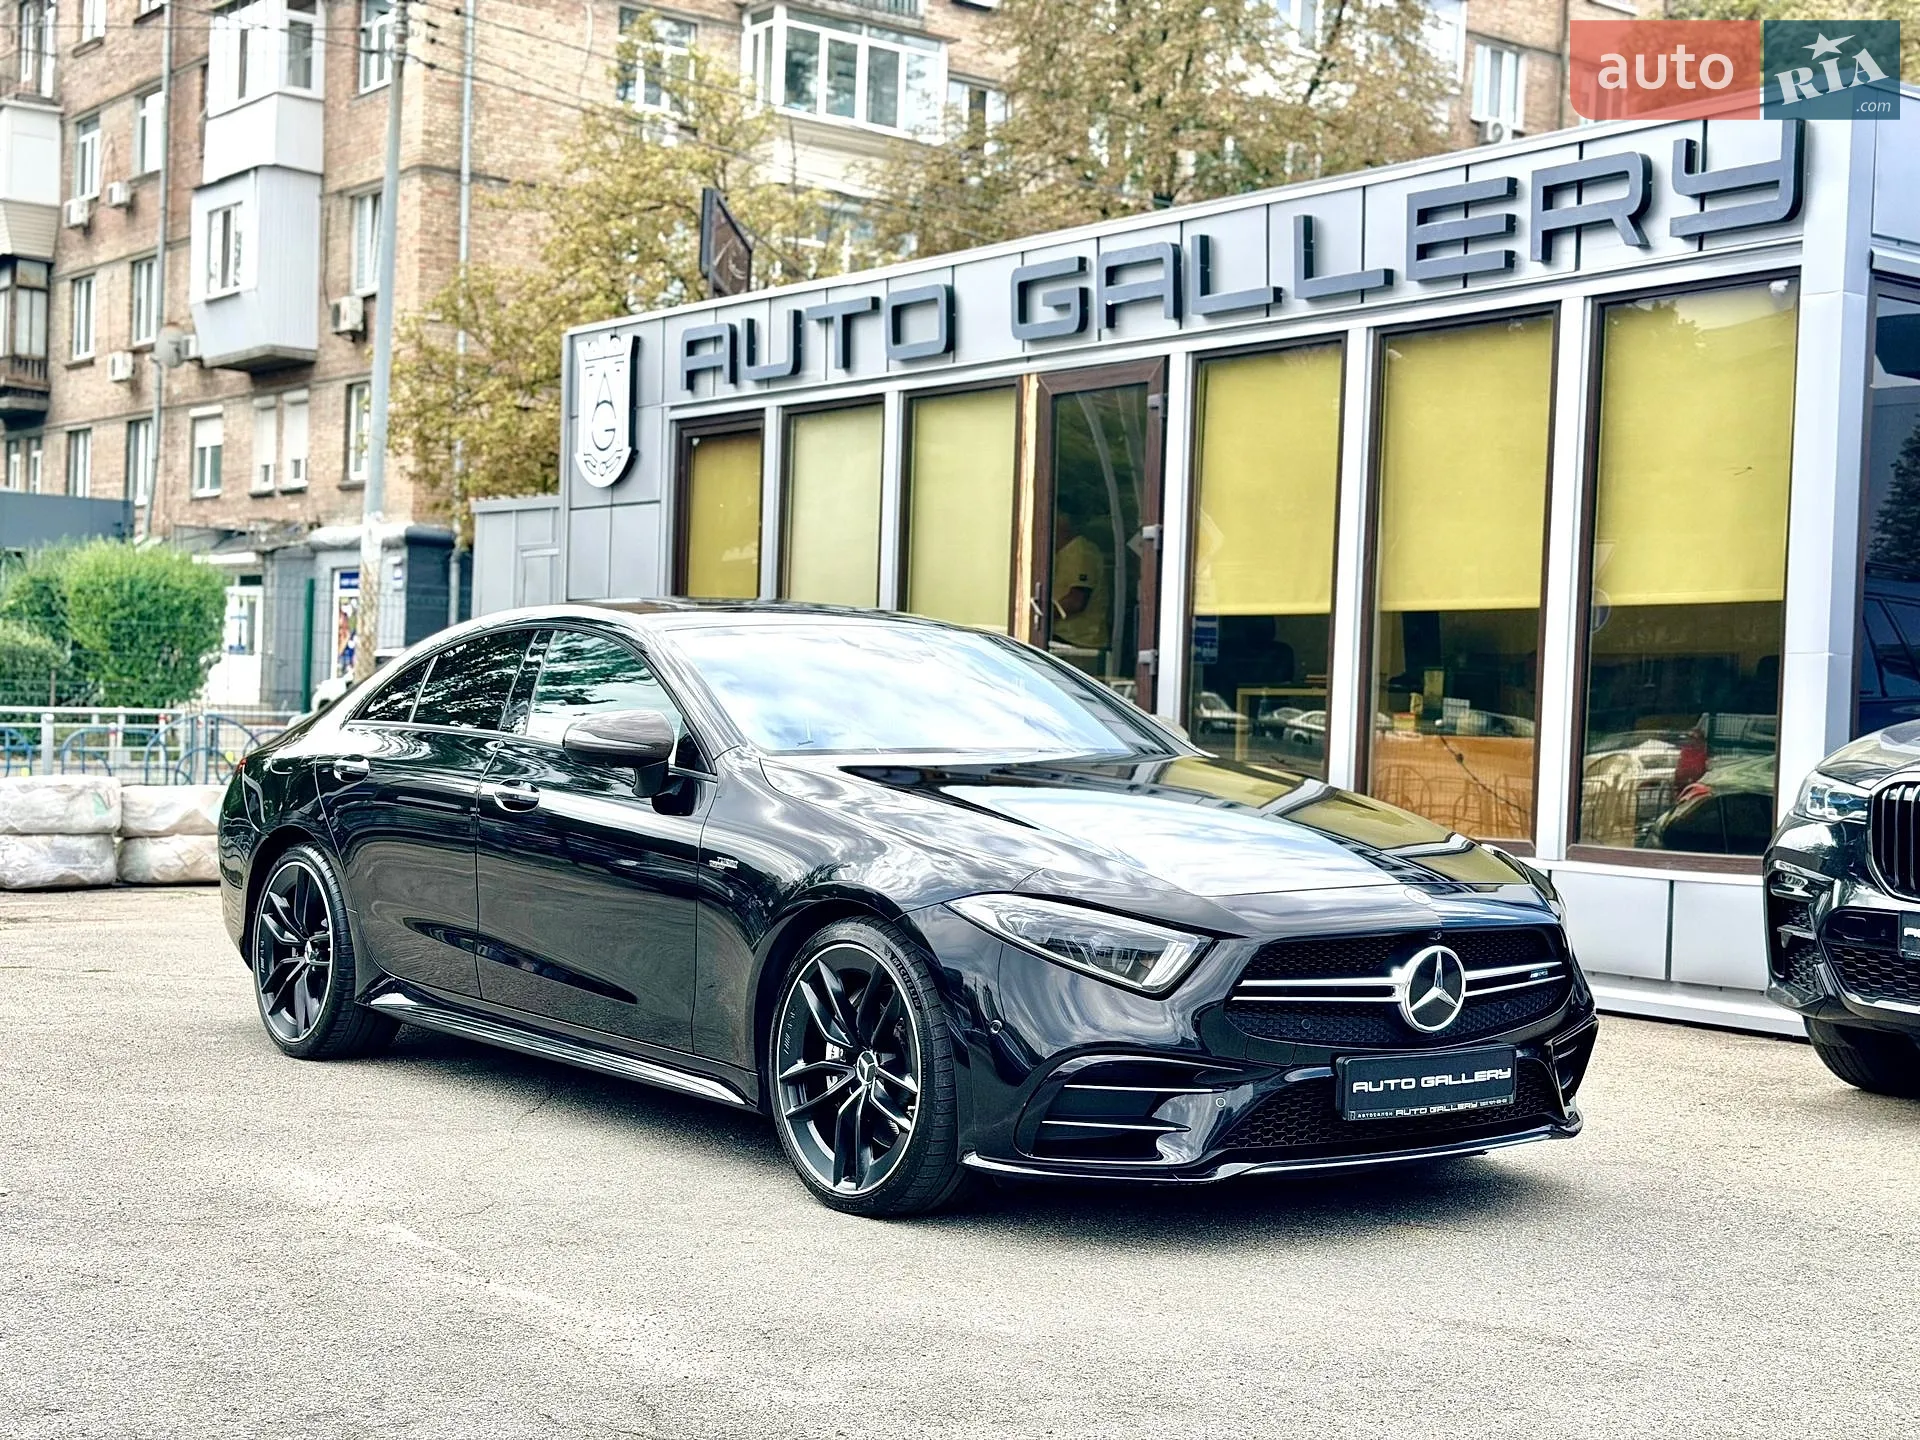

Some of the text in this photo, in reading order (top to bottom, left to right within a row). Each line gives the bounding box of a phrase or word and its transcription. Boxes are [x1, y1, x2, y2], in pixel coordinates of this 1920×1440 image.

[680, 118, 1806, 391] AUTO GALLERY
[892, 957, 921, 1007] MICHELIN
[1352, 1067, 1512, 1093] AUTO GALLERY
[1395, 1106, 1428, 1117] AUTO
[1429, 1101, 1478, 1114] GALLERY
